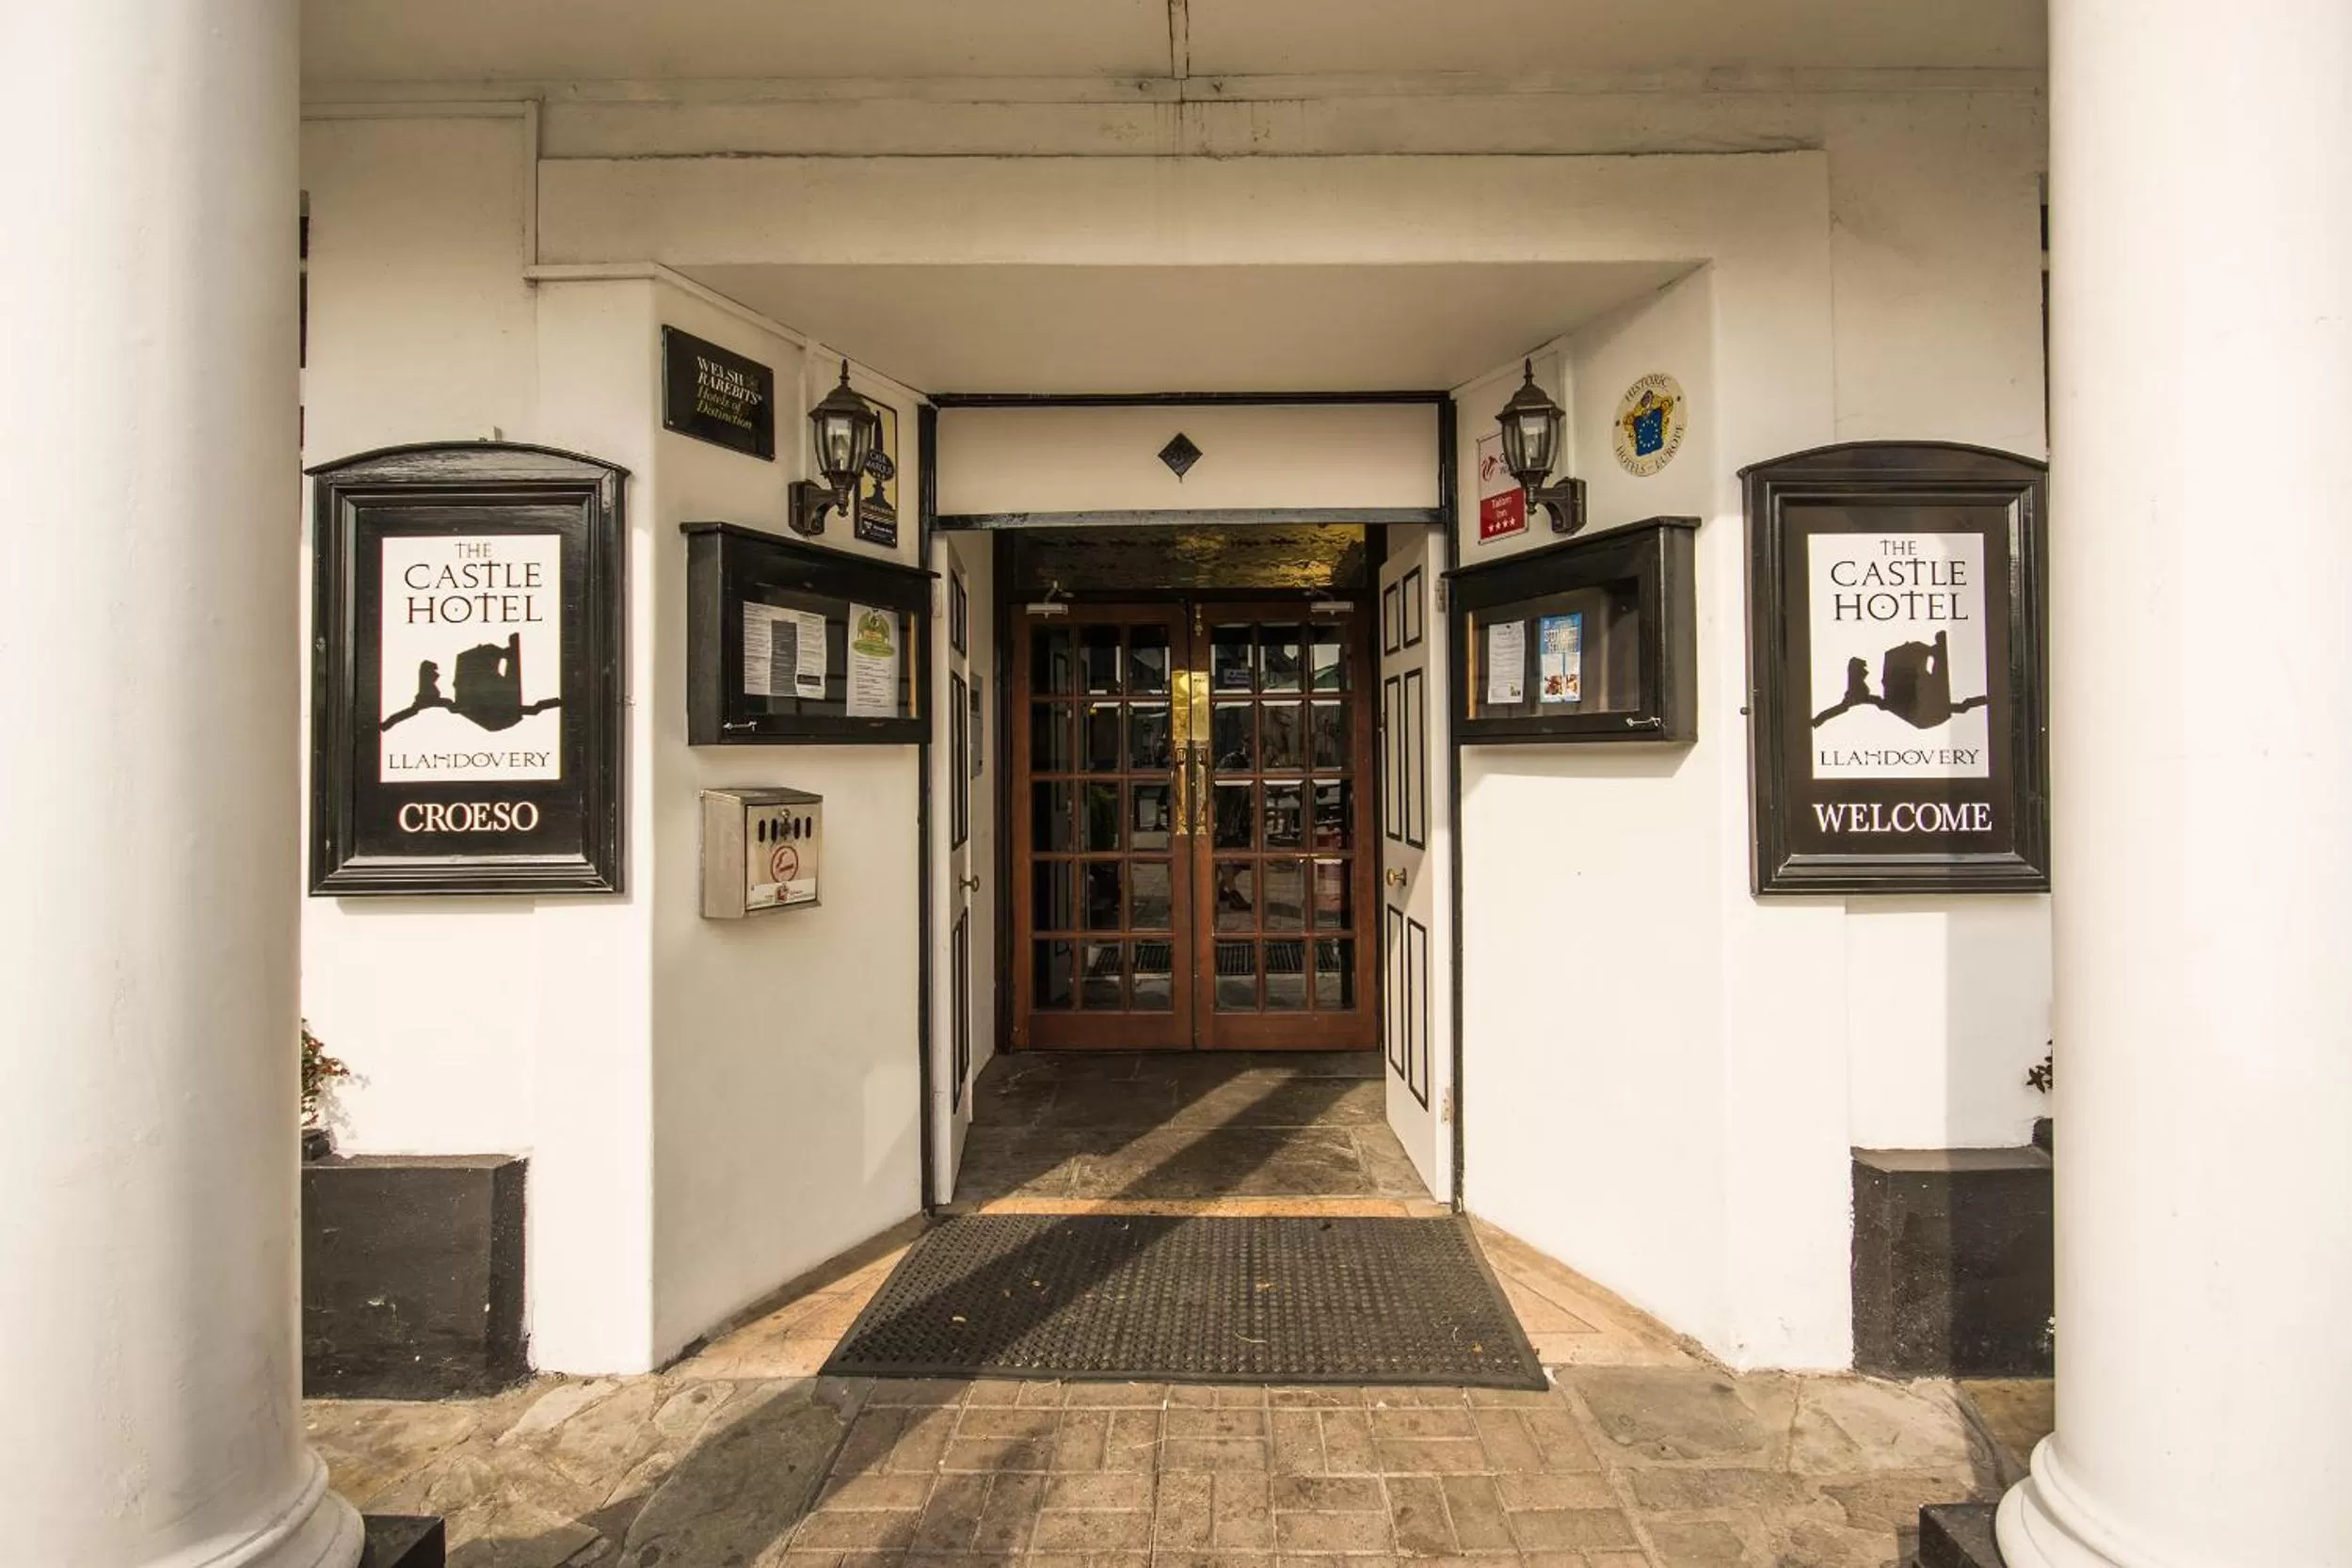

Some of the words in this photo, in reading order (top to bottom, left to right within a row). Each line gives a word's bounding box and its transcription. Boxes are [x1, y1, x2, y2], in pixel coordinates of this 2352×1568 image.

[697, 356, 744, 387] WELSH
[1624, 374, 1668, 402] HISTORIC
[1656, 424, 1683, 469] EUROPE
[455, 542, 492, 559] THE
[1880, 539, 1916, 556] THE
[405, 560, 542, 590] CASTLE
[1831, 557, 1967, 586] CASTLE
[407, 592, 543, 624] HOTEL
[1833, 590, 1968, 621] HOTEL
[389, 752, 551, 770] LLANDOVERY
[1820, 748, 1980, 766] LLANDOVERY
[398, 802, 538, 833] CROESO
[1813, 803, 1992, 833] WELCOME
